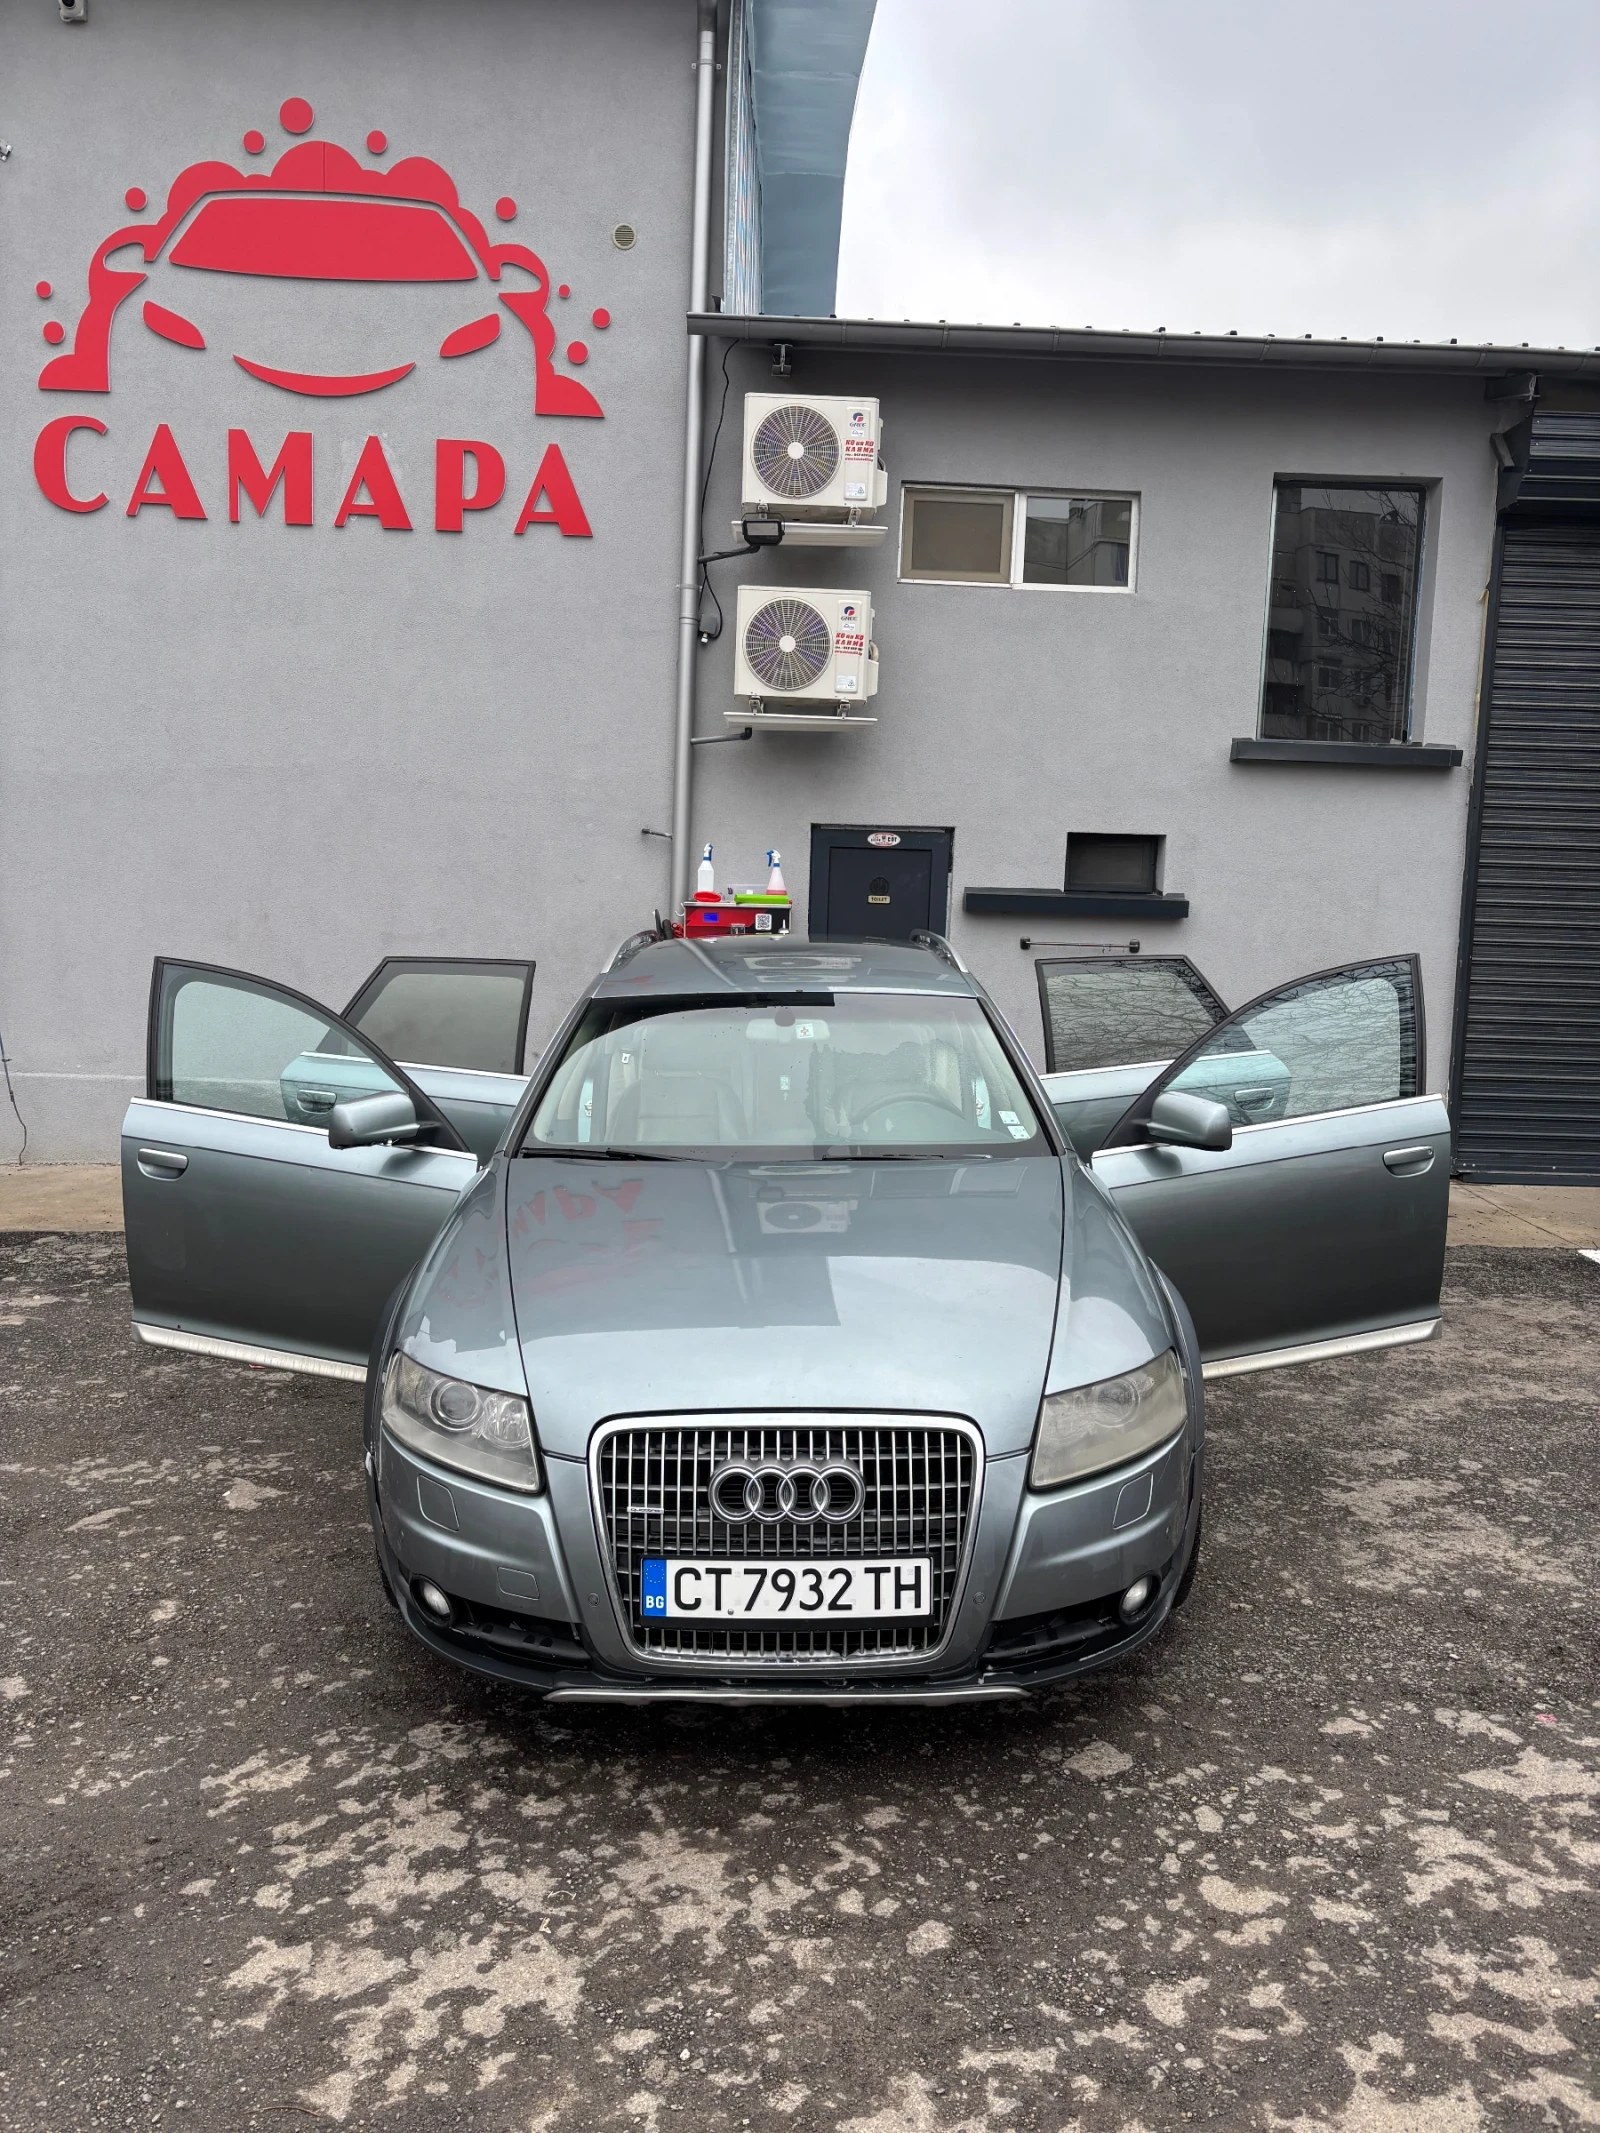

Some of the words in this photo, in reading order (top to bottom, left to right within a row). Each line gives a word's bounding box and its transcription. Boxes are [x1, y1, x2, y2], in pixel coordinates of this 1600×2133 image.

[33, 415, 593, 537] САМАРА
[645, 1595, 665, 1609] BG
[743, 1567, 853, 1612] 7932
